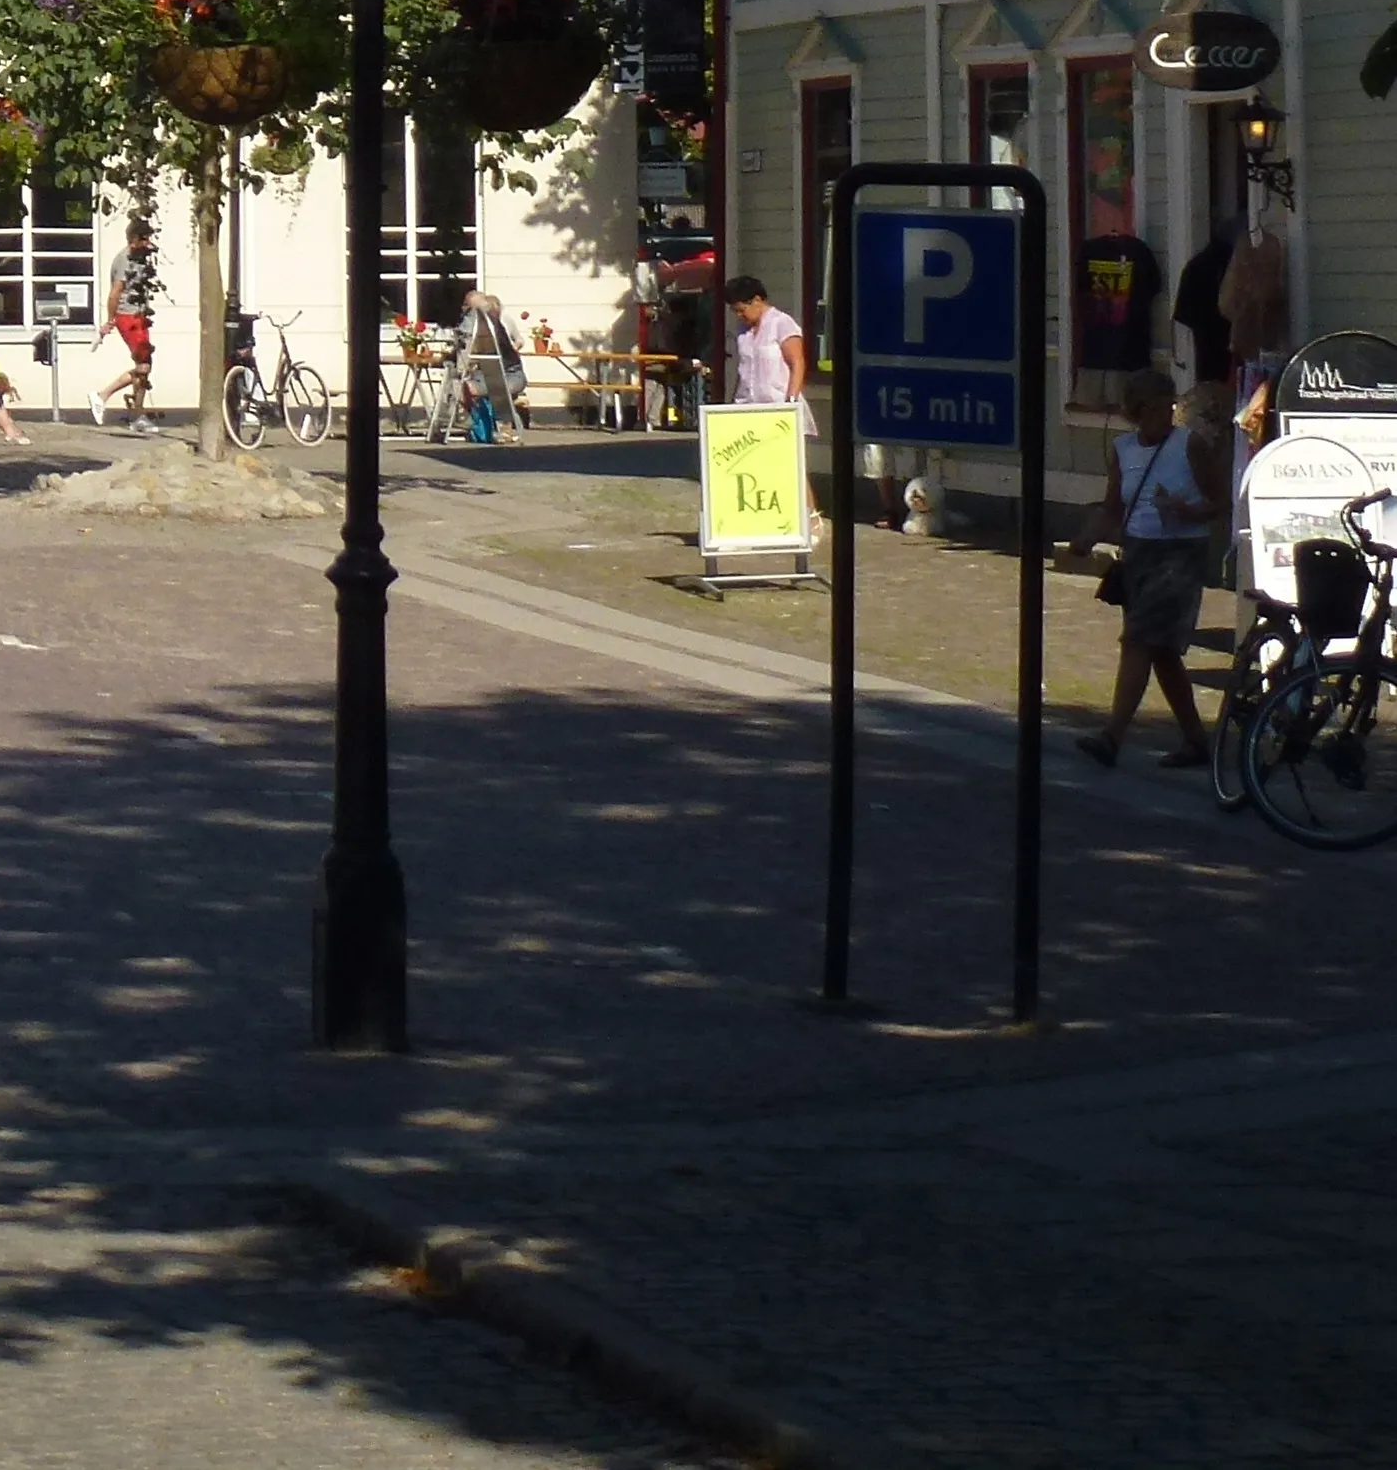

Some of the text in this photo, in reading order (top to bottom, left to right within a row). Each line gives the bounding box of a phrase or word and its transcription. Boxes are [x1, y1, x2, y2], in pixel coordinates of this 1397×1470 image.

[903, 227, 974, 343] P
[877, 385, 995, 425] 15 min
[731, 472, 782, 514] REA
